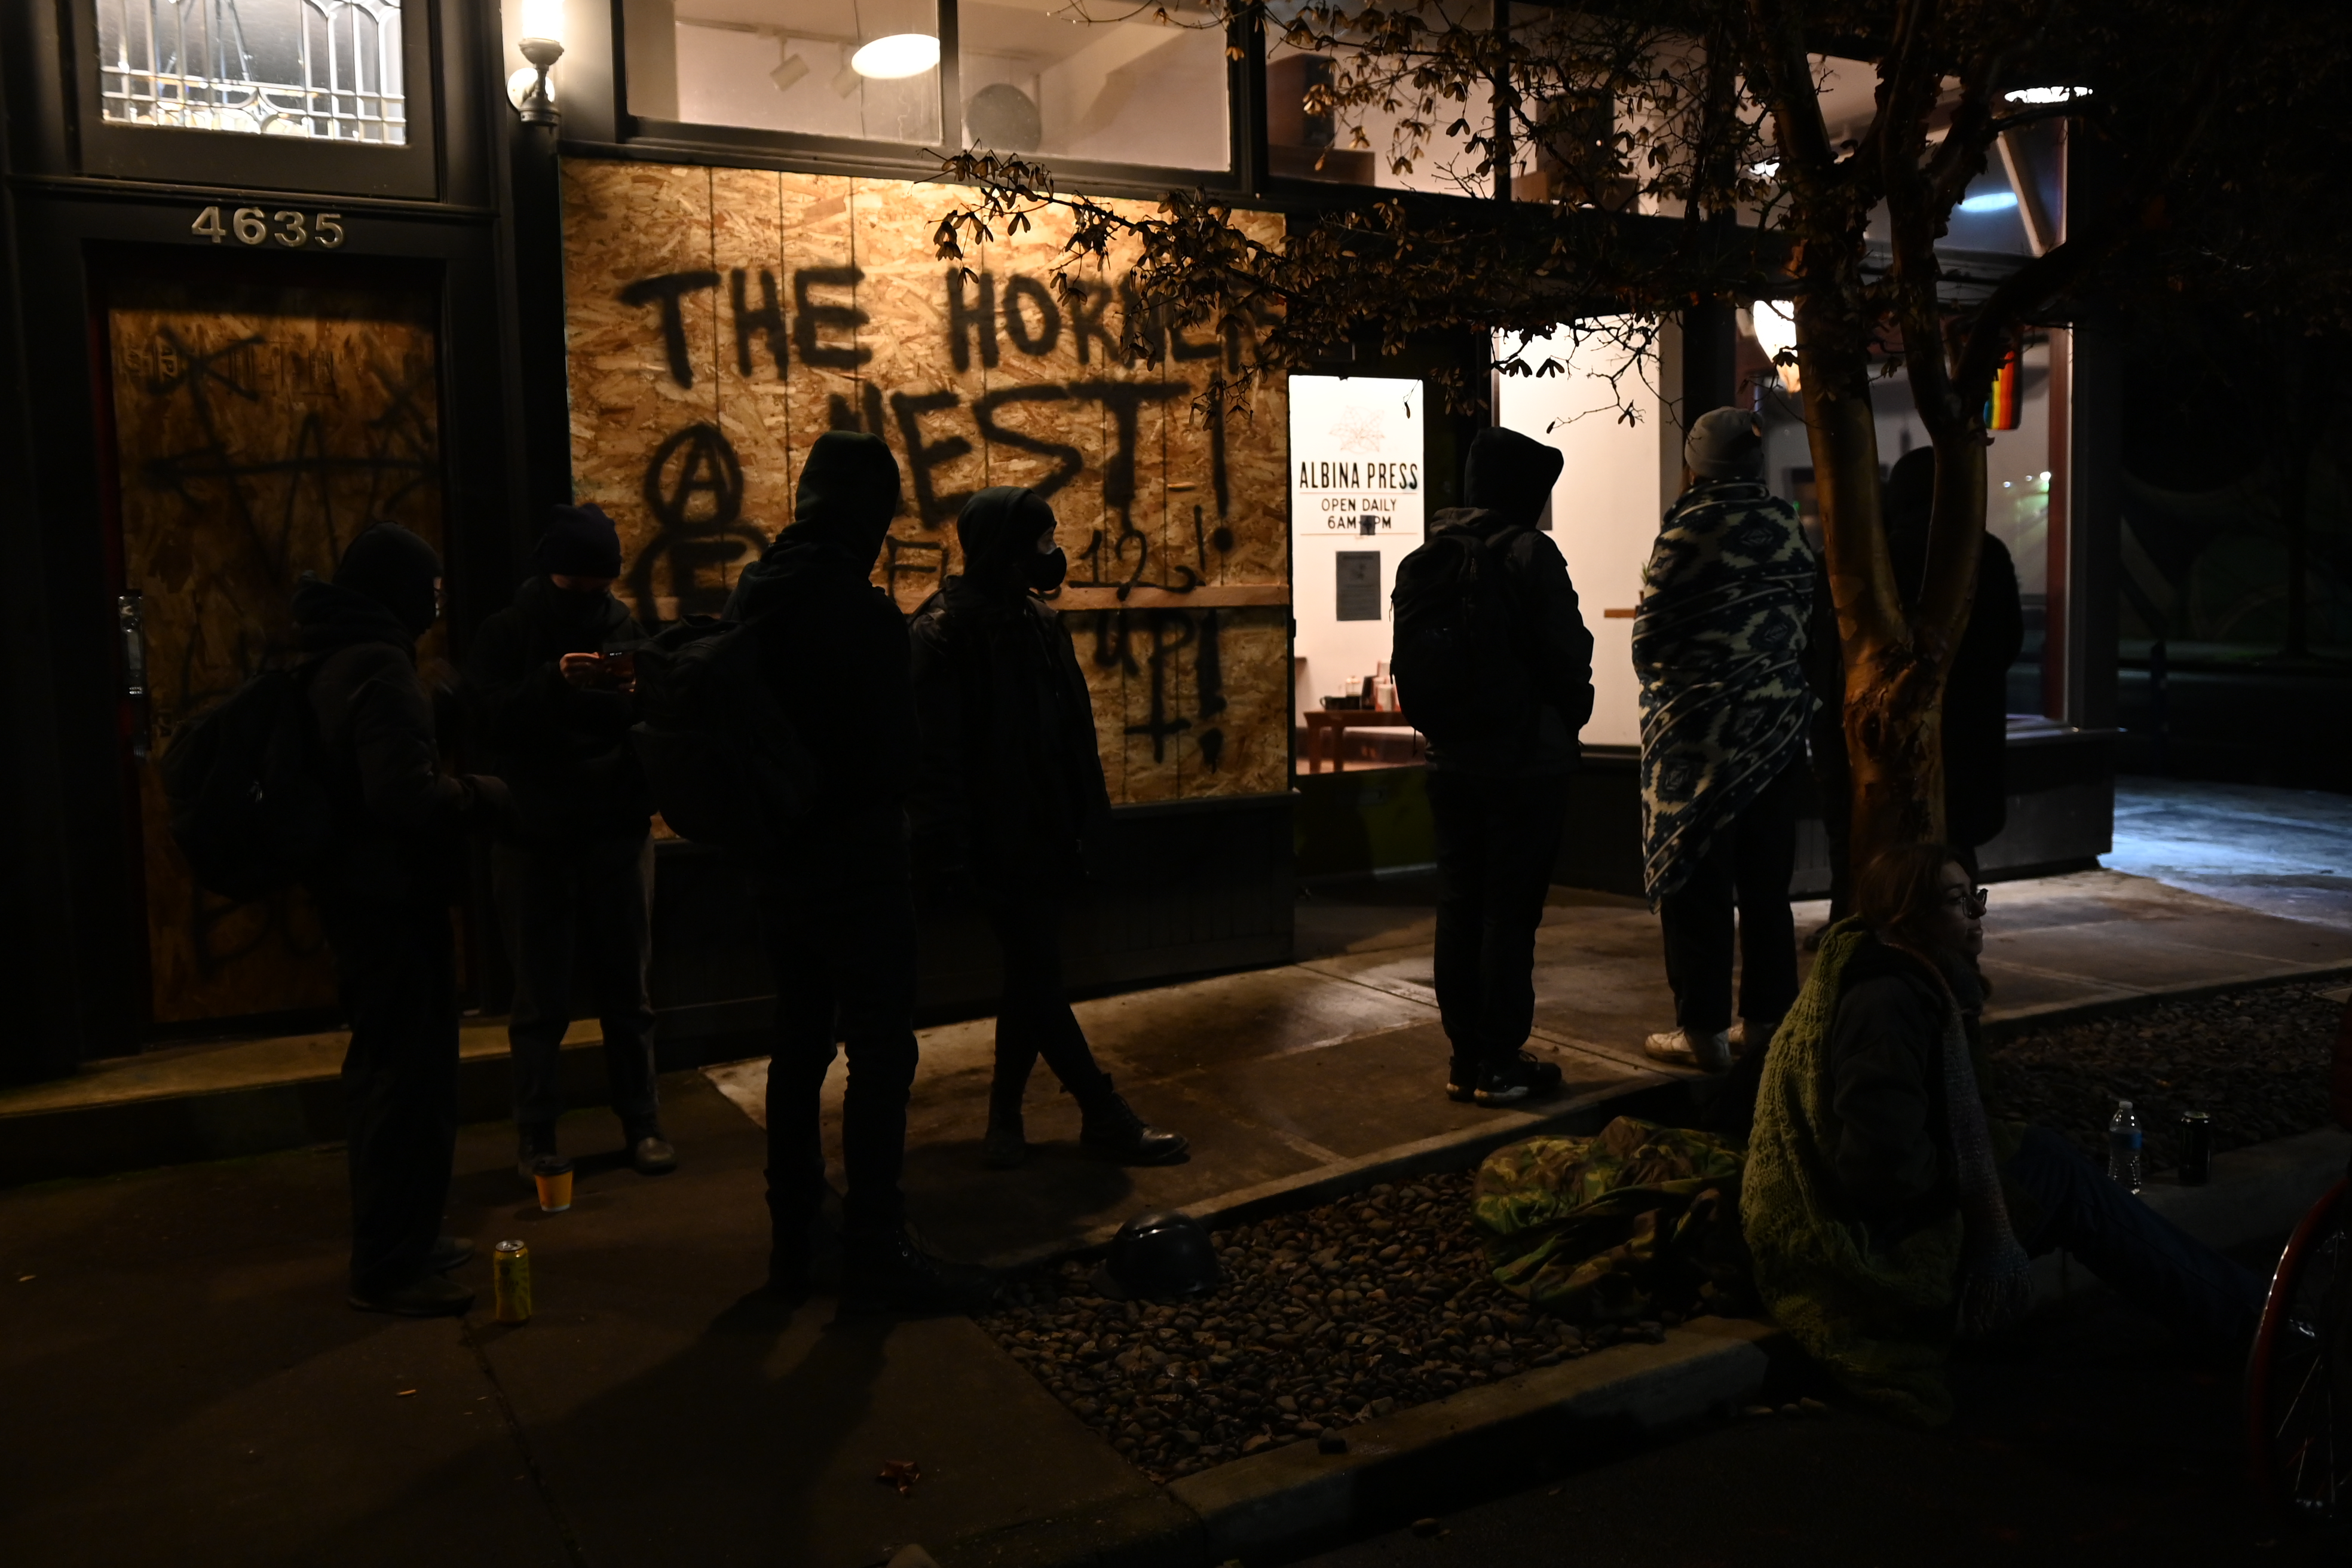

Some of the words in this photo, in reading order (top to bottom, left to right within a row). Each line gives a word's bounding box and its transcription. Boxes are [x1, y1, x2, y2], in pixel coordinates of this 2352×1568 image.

[192, 206, 347, 249] 4635
[619, 267, 872, 390] THE
[1300, 461, 1359, 489] ALBINA
[1367, 463, 1417, 489] PRESS
[1321, 498, 1356, 512] OPEN
[1362, 498, 1396, 512] DAILY
